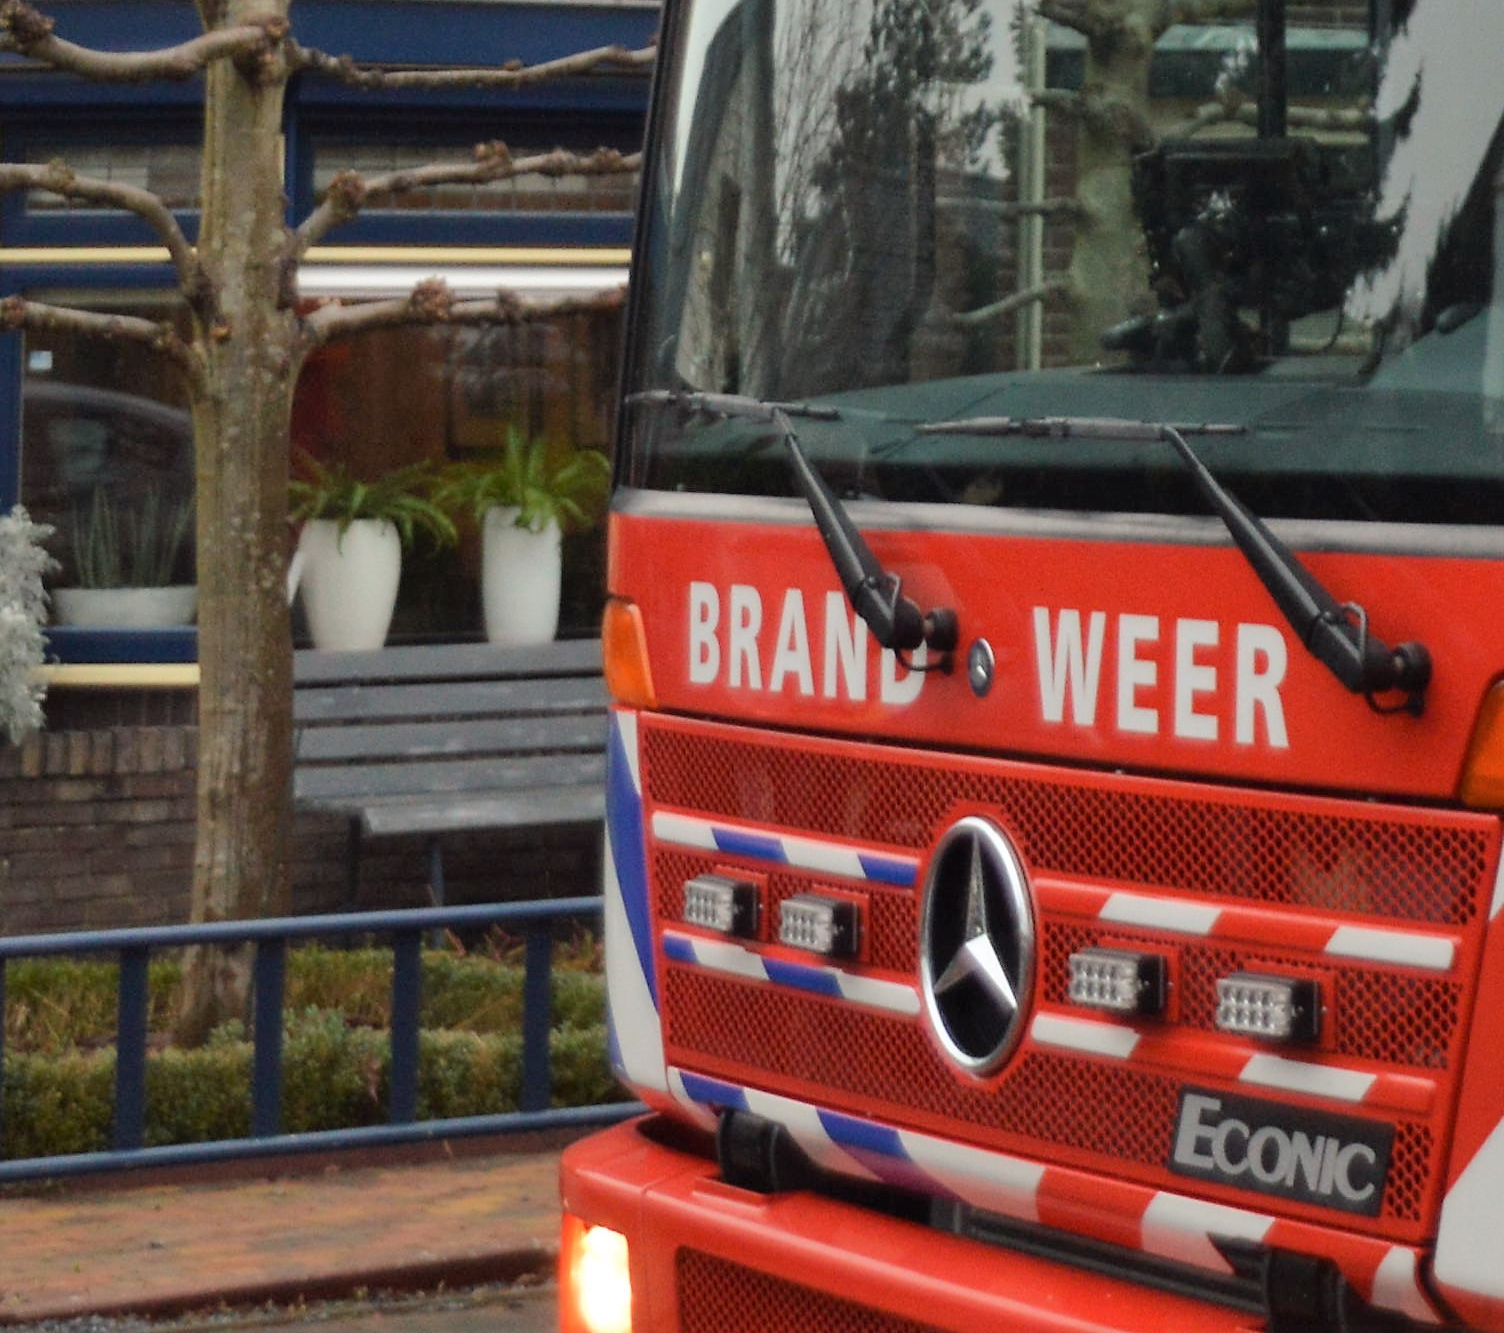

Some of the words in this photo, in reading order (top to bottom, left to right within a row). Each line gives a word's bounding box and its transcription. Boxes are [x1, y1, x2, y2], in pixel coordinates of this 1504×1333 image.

[689, 581, 929, 705] BRAND
[1033, 606, 1289, 748] WEER
[1174, 1093, 1377, 1201] ECONIC
